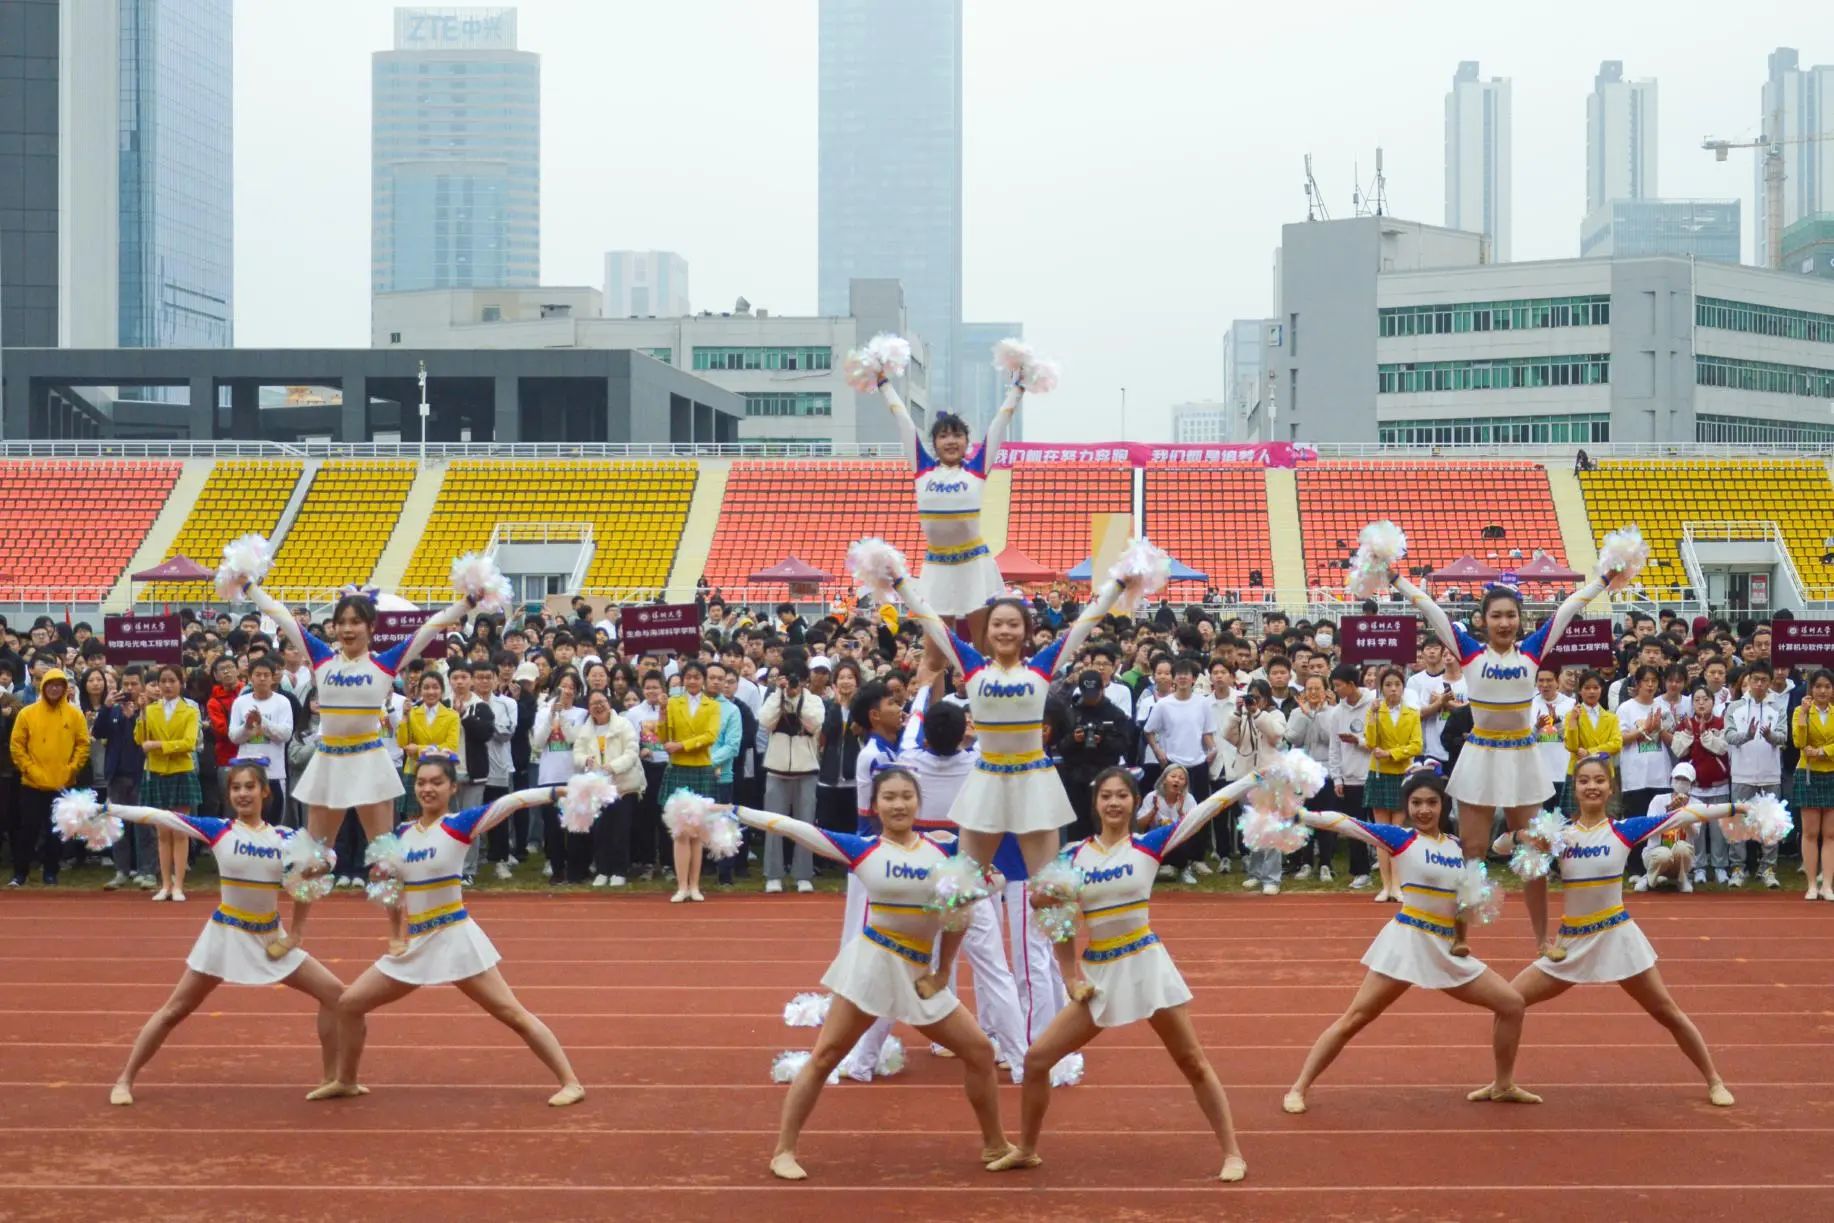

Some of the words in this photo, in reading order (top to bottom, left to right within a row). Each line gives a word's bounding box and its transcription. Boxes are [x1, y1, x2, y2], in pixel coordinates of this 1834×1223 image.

[626, 627, 697, 638] 生命与海洋科学学院
[108, 639, 179, 649] 物理与光电工程学院
[1356, 637, 1398, 647] 材料学院
